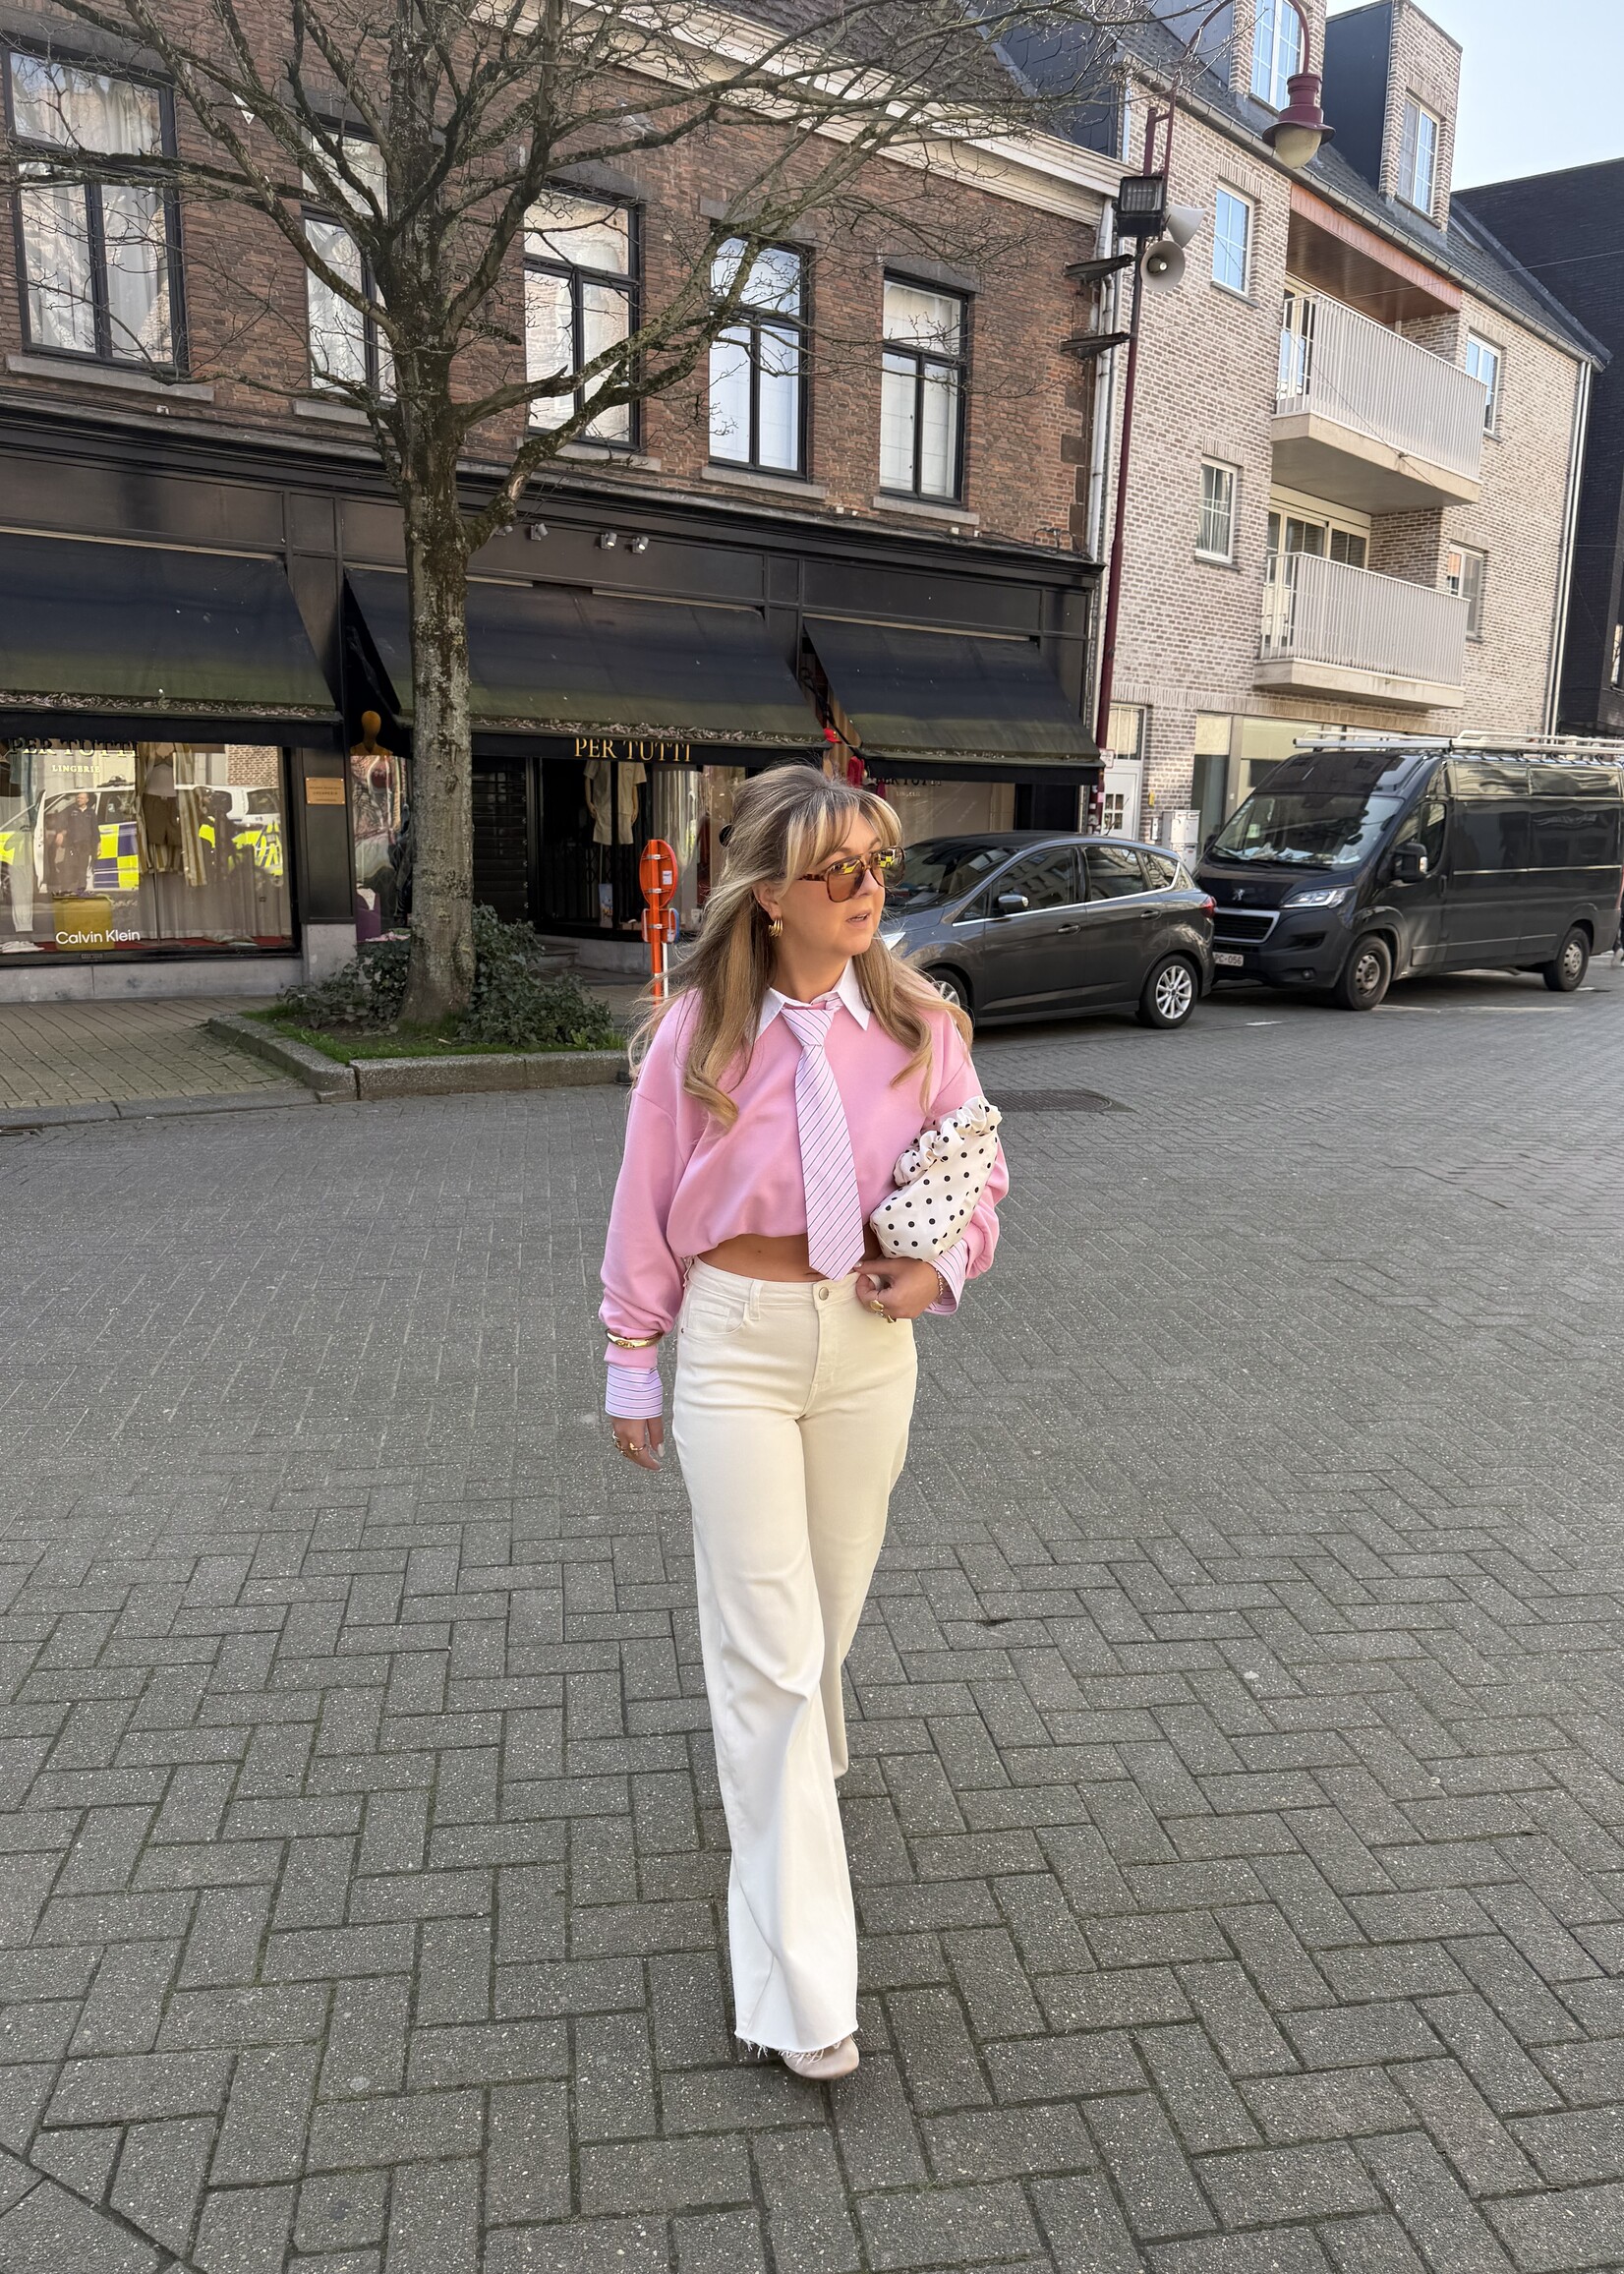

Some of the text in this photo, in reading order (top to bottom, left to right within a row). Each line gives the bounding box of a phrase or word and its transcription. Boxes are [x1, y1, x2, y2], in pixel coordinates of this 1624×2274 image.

[8, 737, 140, 758] PER TUTTI
[574, 737, 691, 762] PER TUTTI
[52, 764, 100, 774] LINGERIE
[55, 929, 141, 945] Calvin Klein
